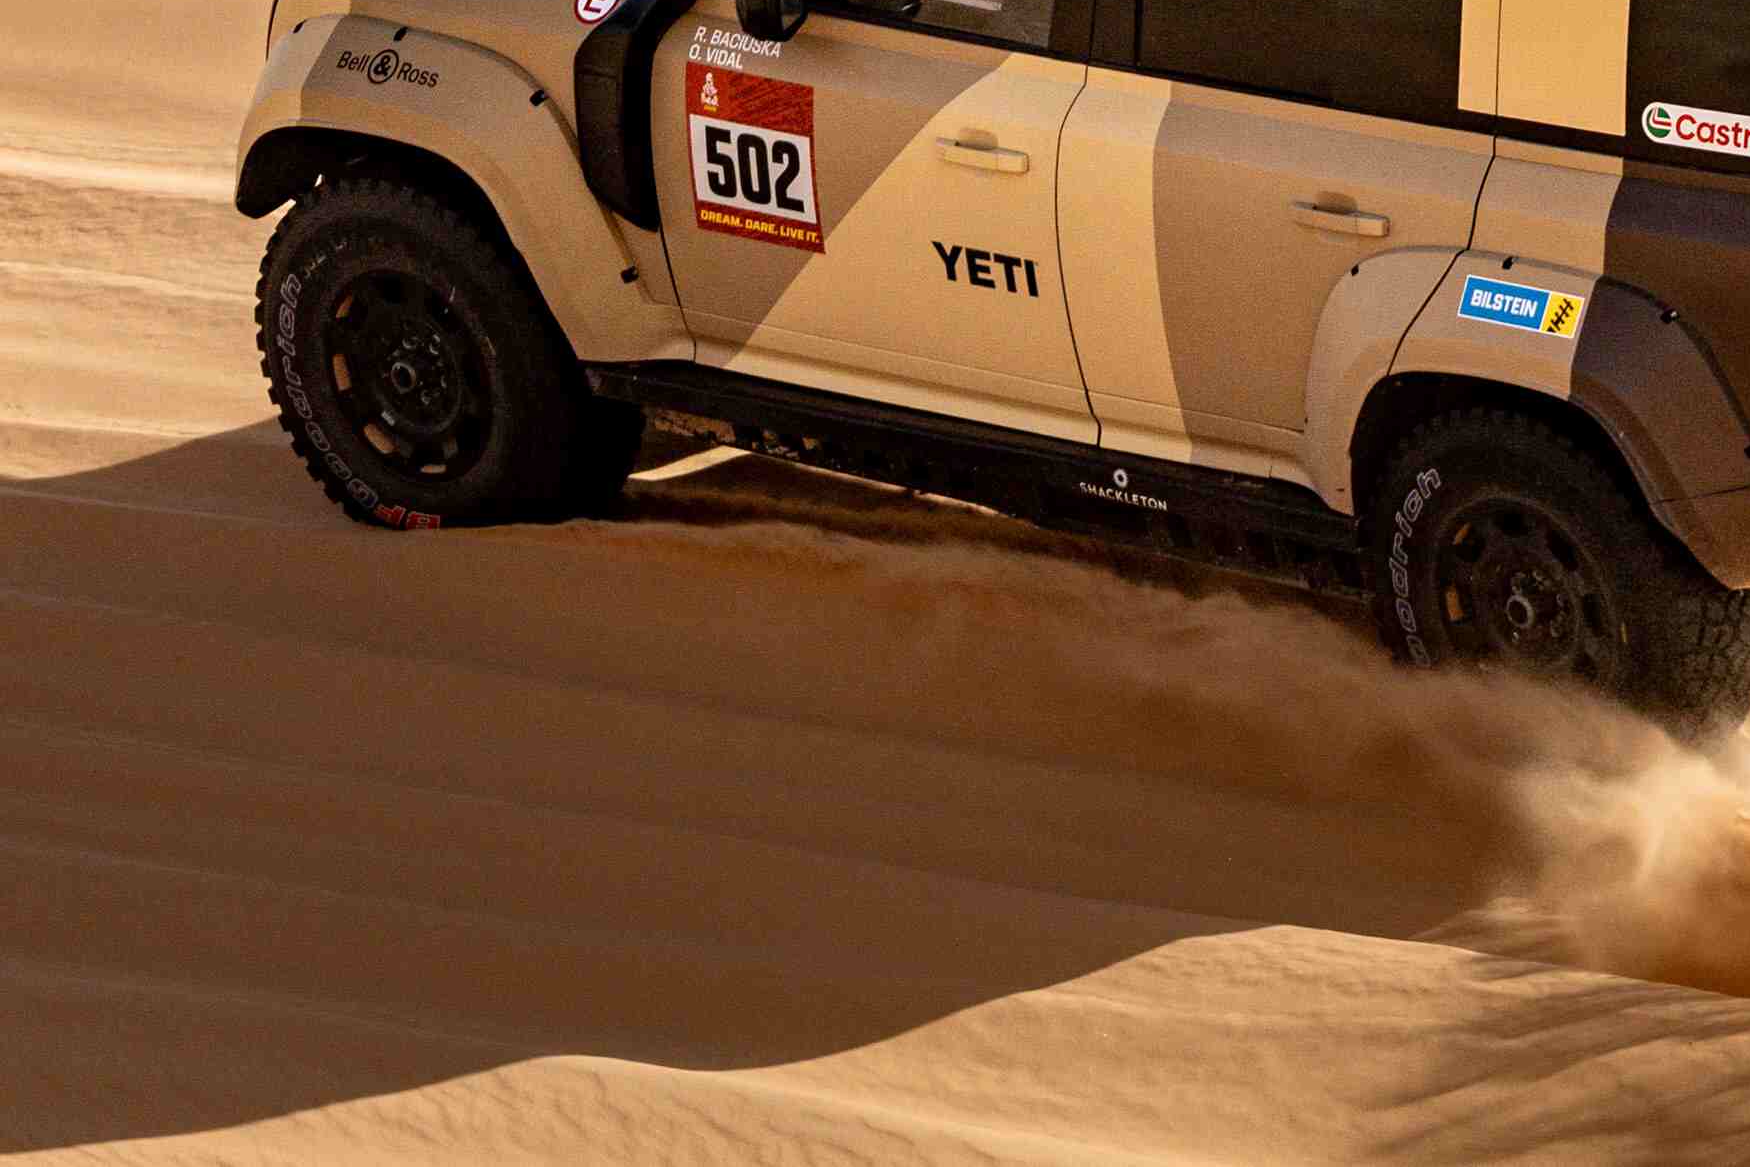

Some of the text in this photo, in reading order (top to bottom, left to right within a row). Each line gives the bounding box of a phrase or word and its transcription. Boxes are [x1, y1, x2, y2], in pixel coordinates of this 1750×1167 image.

[694, 25, 706, 43] R.
[336, 49, 369, 72] Bell
[397, 61, 440, 88] Ross
[689, 43, 743, 70] O. VIDAL
[705, 125, 805, 214] 502
[700, 209, 820, 243] DREAM. DARE. LIVE IT.
[931, 240, 1039, 298] YETI
[1470, 288, 1539, 318] BILSTEIN
[1079, 481, 1168, 512] SHACKLETON
